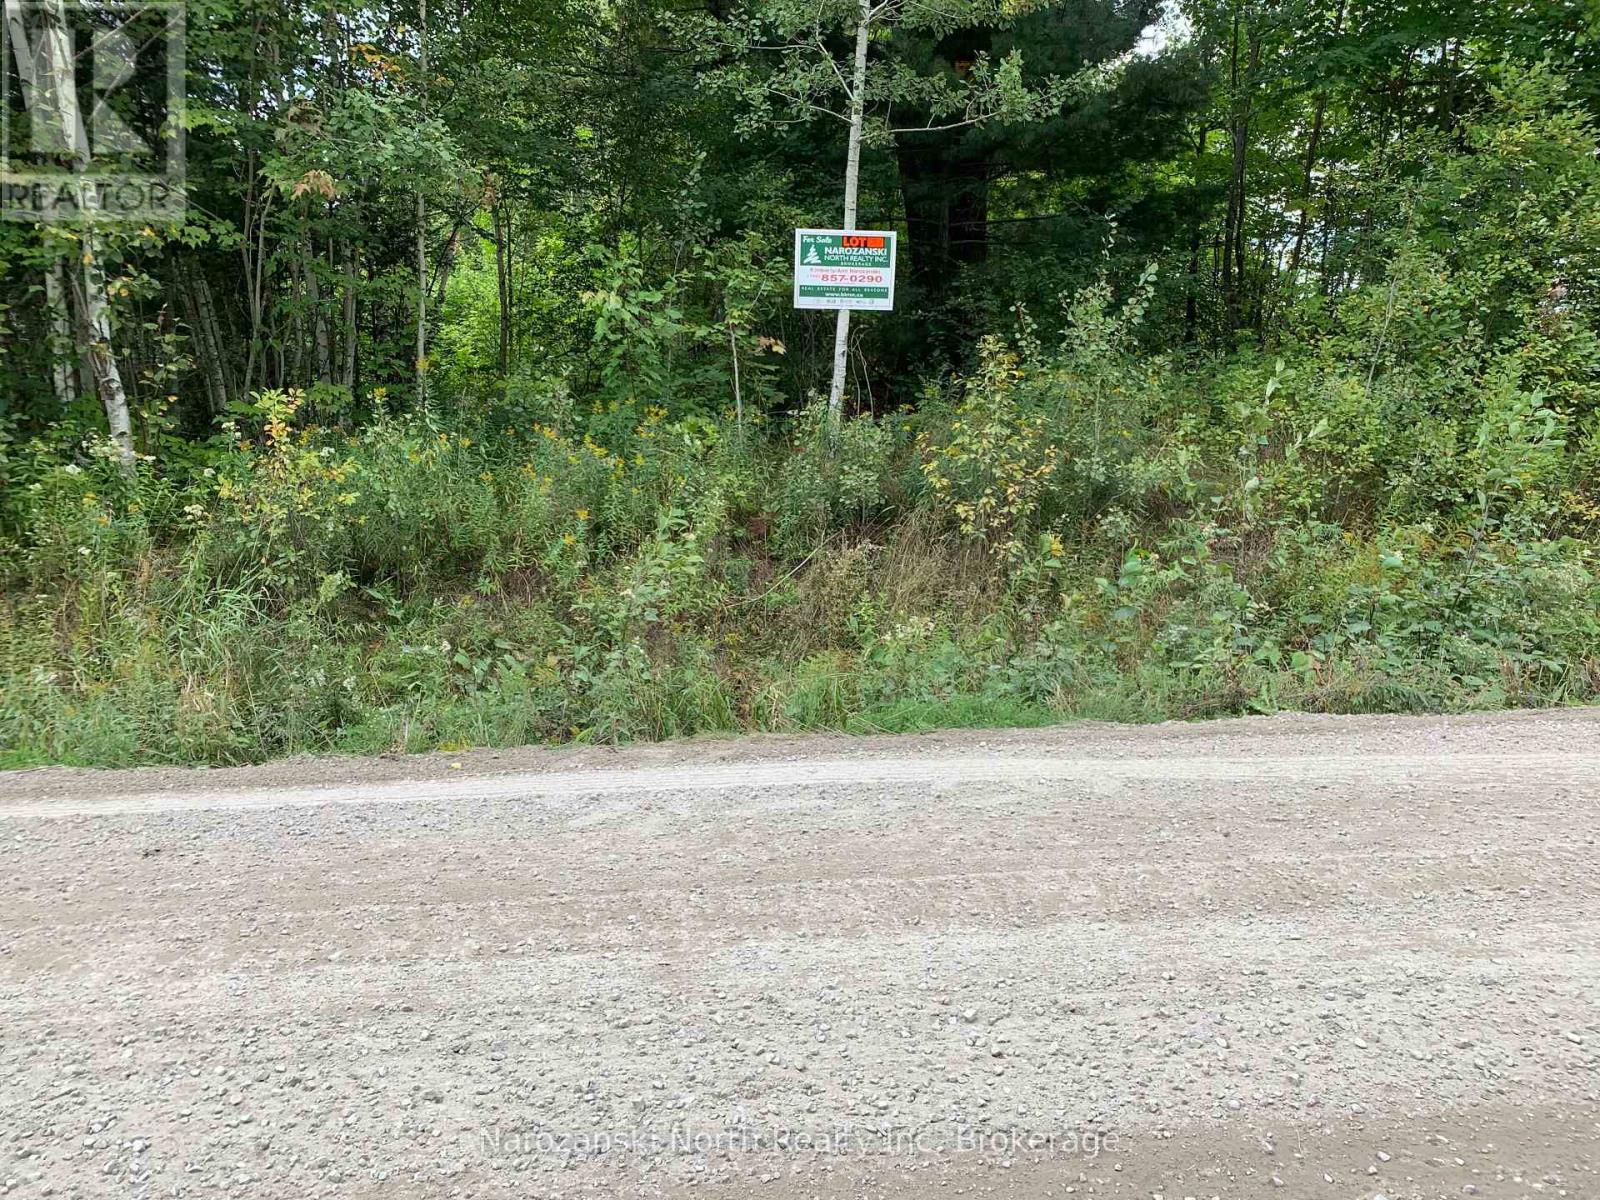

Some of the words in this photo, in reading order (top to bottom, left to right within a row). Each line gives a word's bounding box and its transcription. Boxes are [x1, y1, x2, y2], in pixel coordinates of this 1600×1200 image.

[803, 235, 815, 243] For
[816, 236, 832, 244] Sale
[843, 236, 867, 247] LOT
[824, 247, 887, 256] NAROZANSKI
[821, 274, 883, 283] 857-0290
